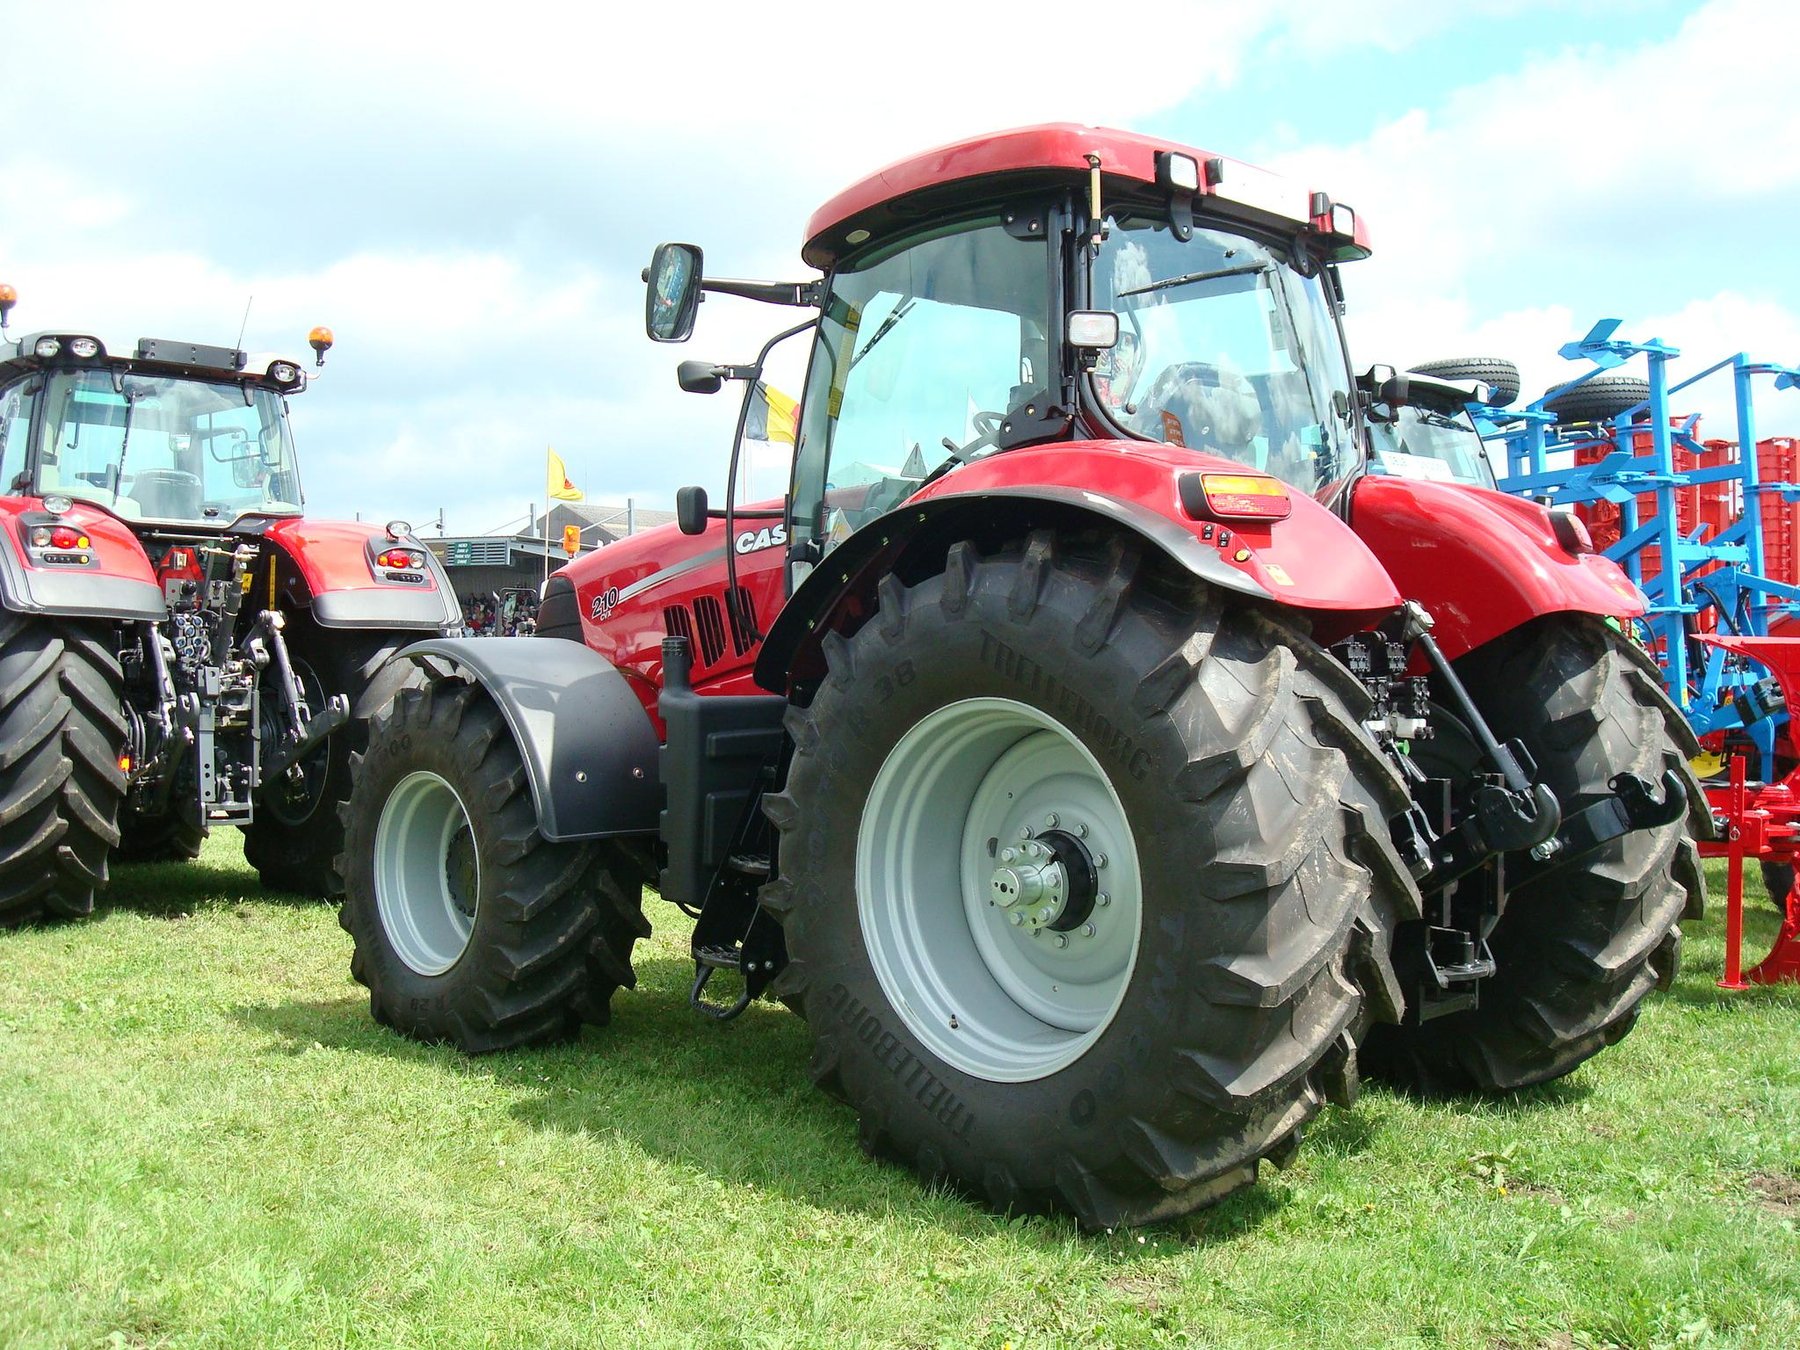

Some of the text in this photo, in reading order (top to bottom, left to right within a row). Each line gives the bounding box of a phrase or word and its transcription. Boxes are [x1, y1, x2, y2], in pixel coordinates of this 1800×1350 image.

[592, 586, 619, 619] 210
[600, 609, 612, 621] CVX
[871, 655, 917, 705] 38
[824, 982, 977, 1139] TRELLEBORG
